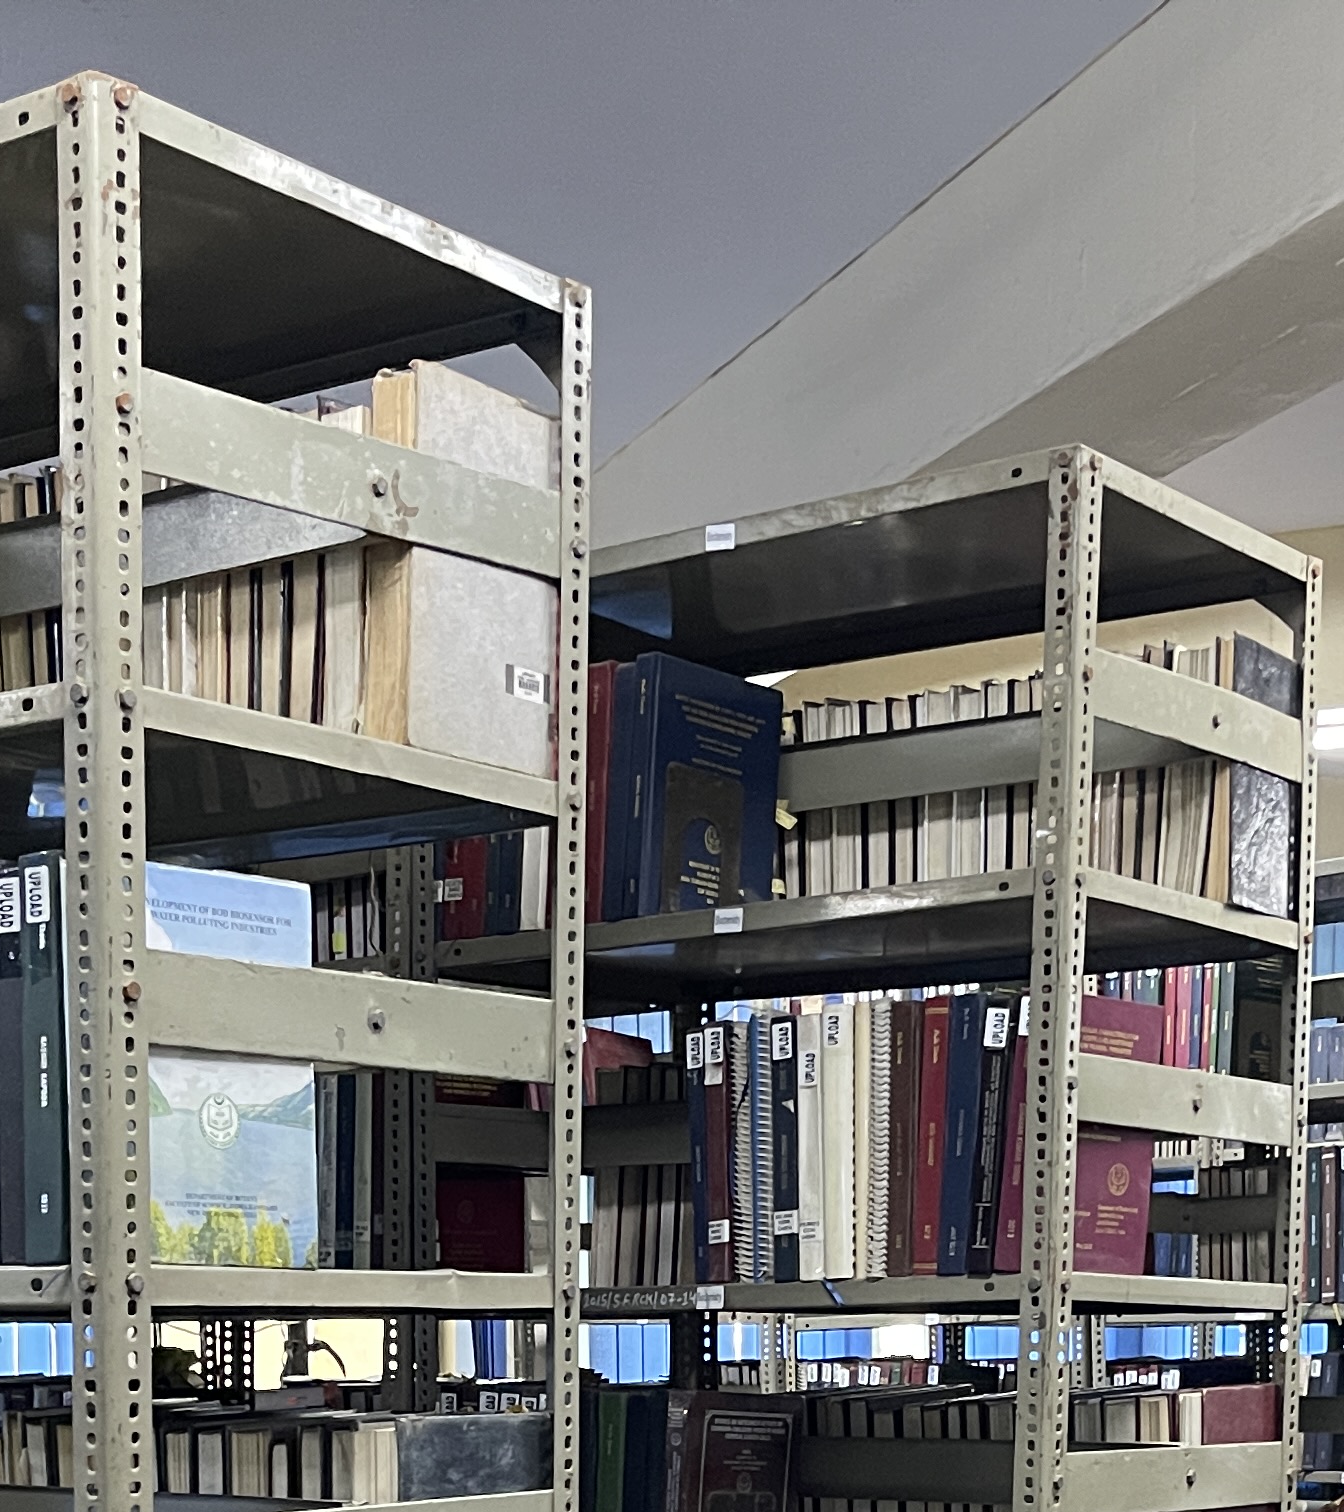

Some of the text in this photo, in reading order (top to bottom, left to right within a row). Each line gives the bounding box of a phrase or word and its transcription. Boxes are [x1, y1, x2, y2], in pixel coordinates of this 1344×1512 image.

[0, 883, 13, 928] UPLOAD
[28, 871, 43, 917] UPLOAD
[991, 1012, 1005, 1045] UPLOAD
[805, 1052, 816, 1083] UPLOAD
